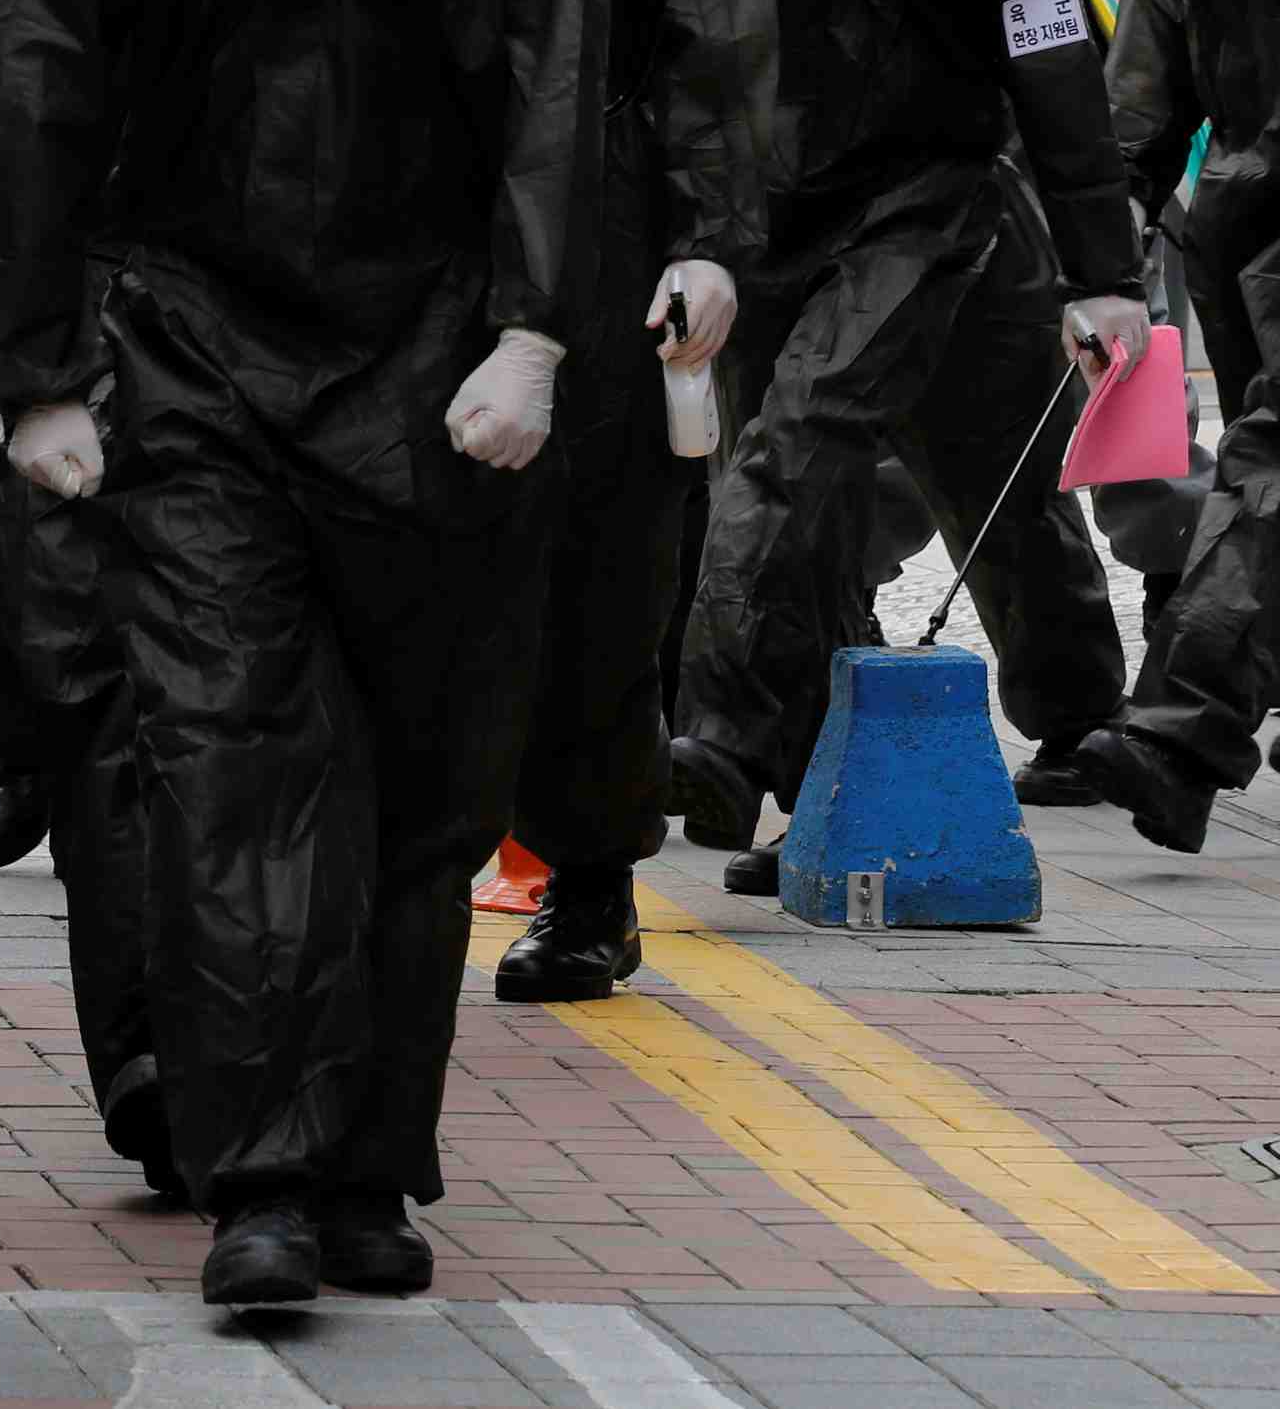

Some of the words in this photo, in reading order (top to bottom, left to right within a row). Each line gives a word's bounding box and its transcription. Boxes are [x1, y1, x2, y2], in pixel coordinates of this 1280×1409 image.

[1009, 3, 1026, 25] 육
[1012, 27, 1038, 49] 현장
[1040, 17, 1080, 42] 지원팀
